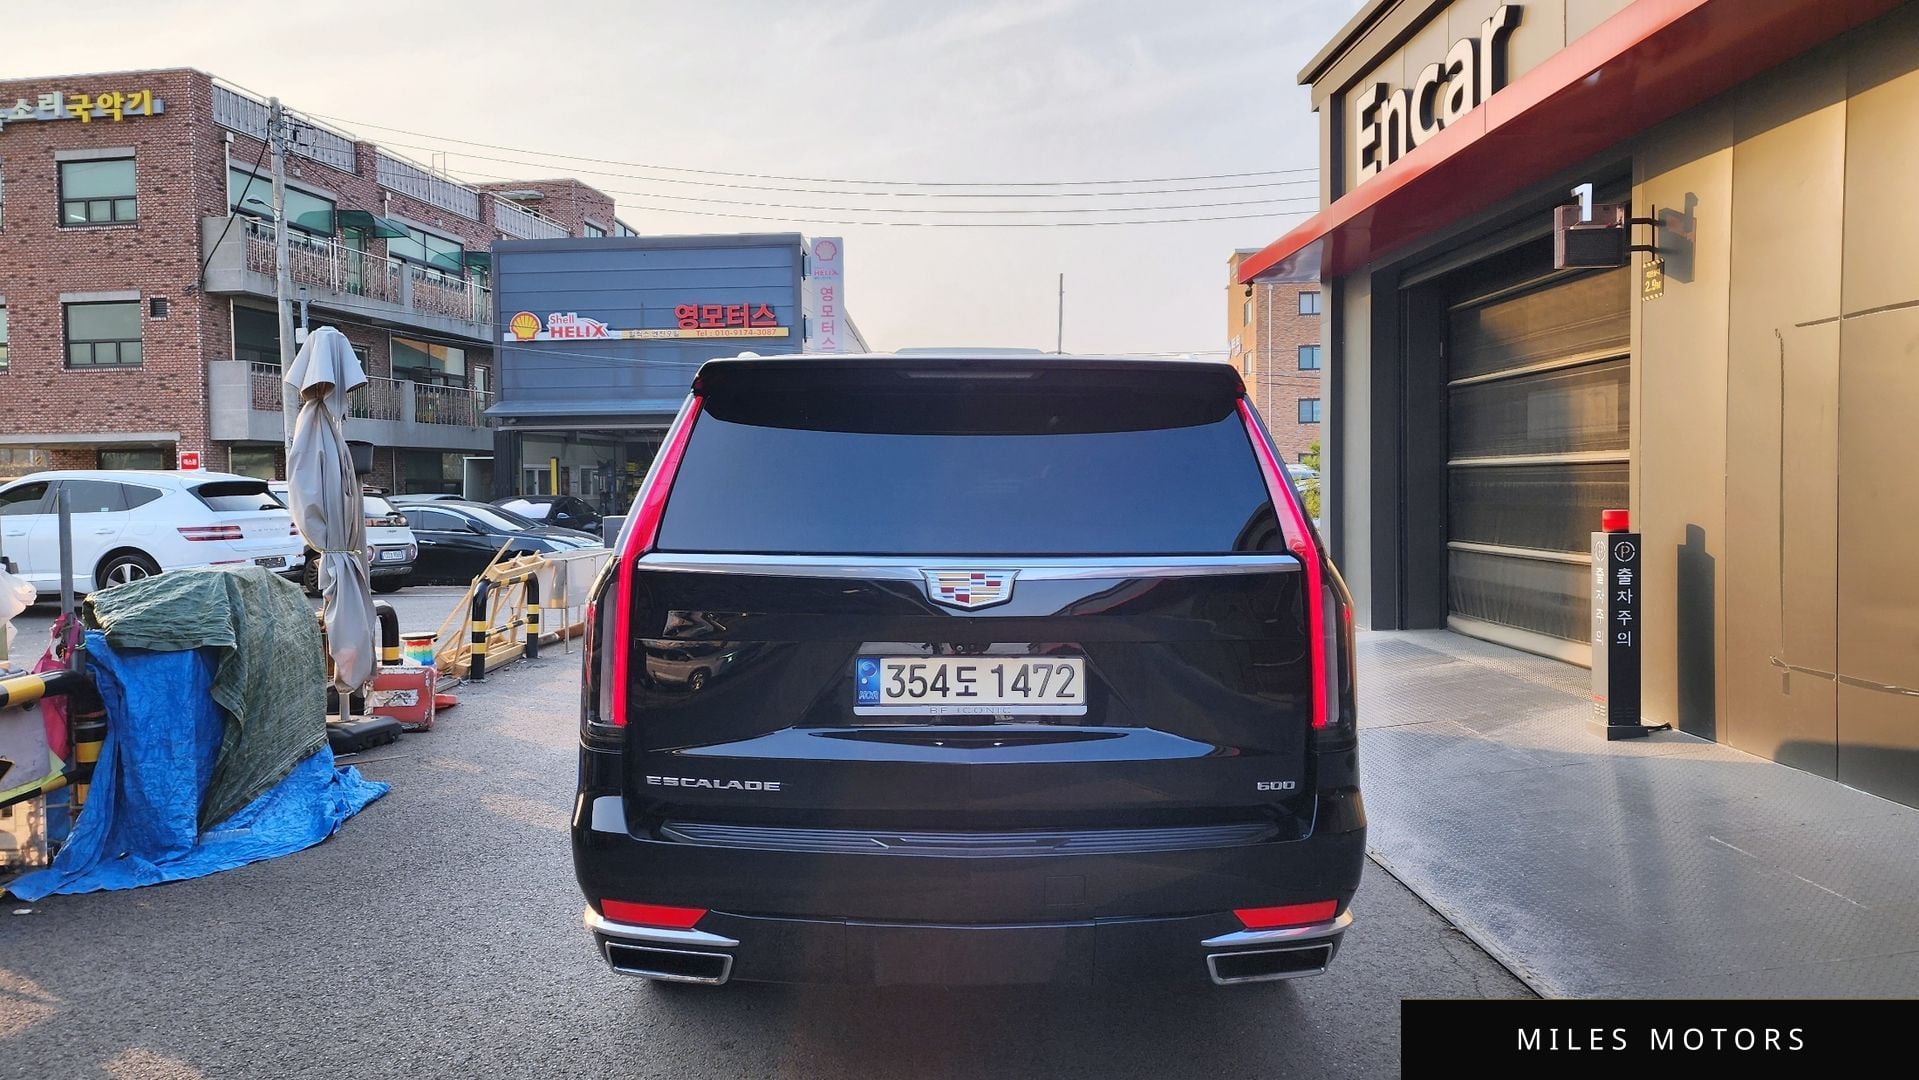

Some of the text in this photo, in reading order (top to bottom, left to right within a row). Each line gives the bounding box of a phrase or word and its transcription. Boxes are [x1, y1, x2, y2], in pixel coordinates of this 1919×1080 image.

[1356, 5, 1520, 188] Encar
[1571, 183, 1593, 222] 1
[550, 314, 575, 324] Shell
[674, 303, 777, 330] 영모터스
[821, 287, 835, 350] 영모터스
[550, 325, 607, 338] HELIX
[886, 663, 1075, 698] 354도 1472
[646, 775, 781, 791] ESCALADE
[1257, 781, 1295, 790] 600
